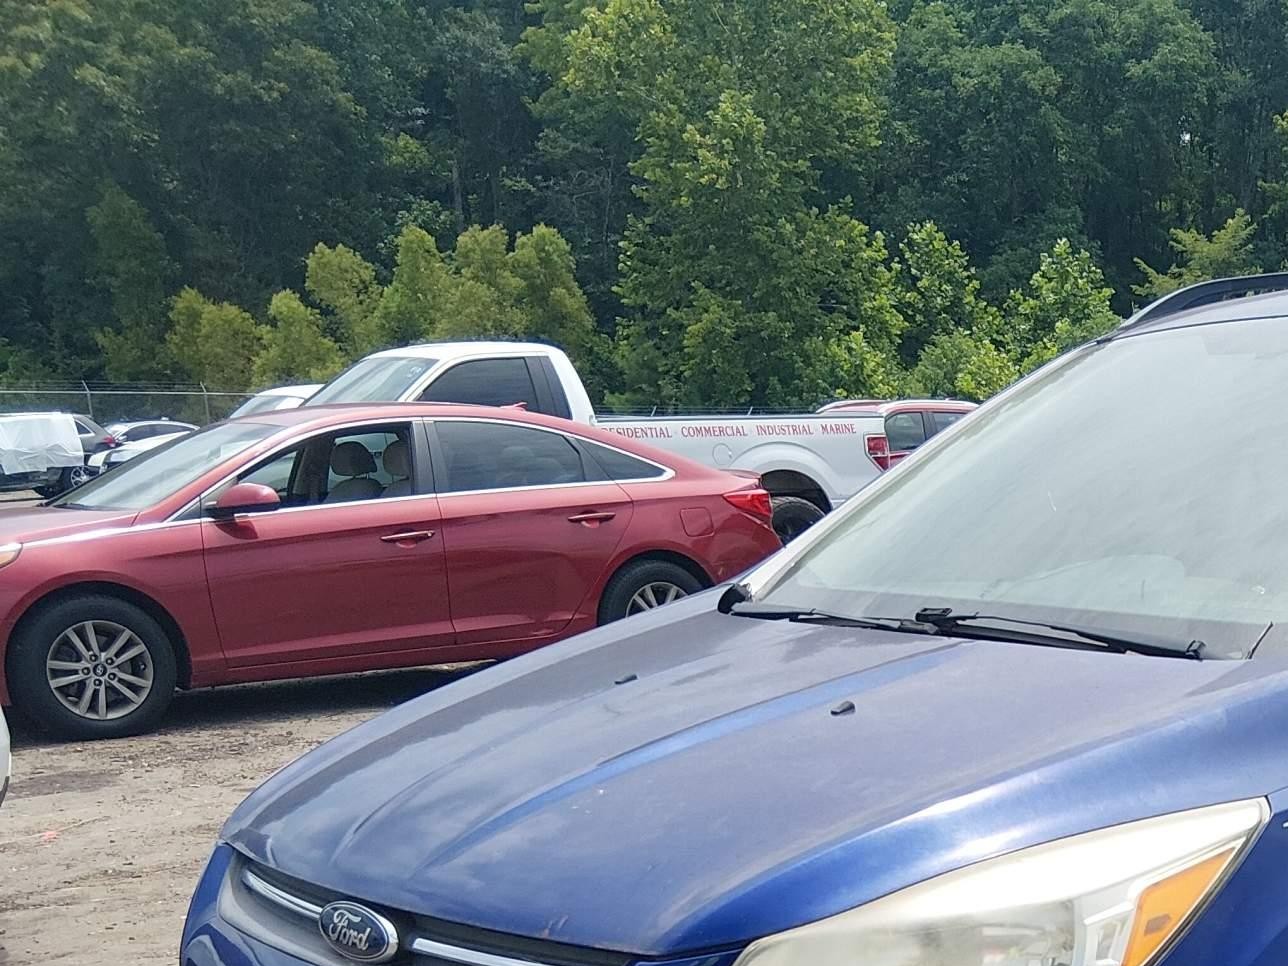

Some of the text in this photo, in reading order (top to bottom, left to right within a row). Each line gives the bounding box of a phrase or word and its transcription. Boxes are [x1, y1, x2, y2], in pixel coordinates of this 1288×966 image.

[600, 423, 857, 439] SIDENTIAL COMMERCIAL INDUSTRIAL MARINE
[328, 909, 372, 951] Ford
